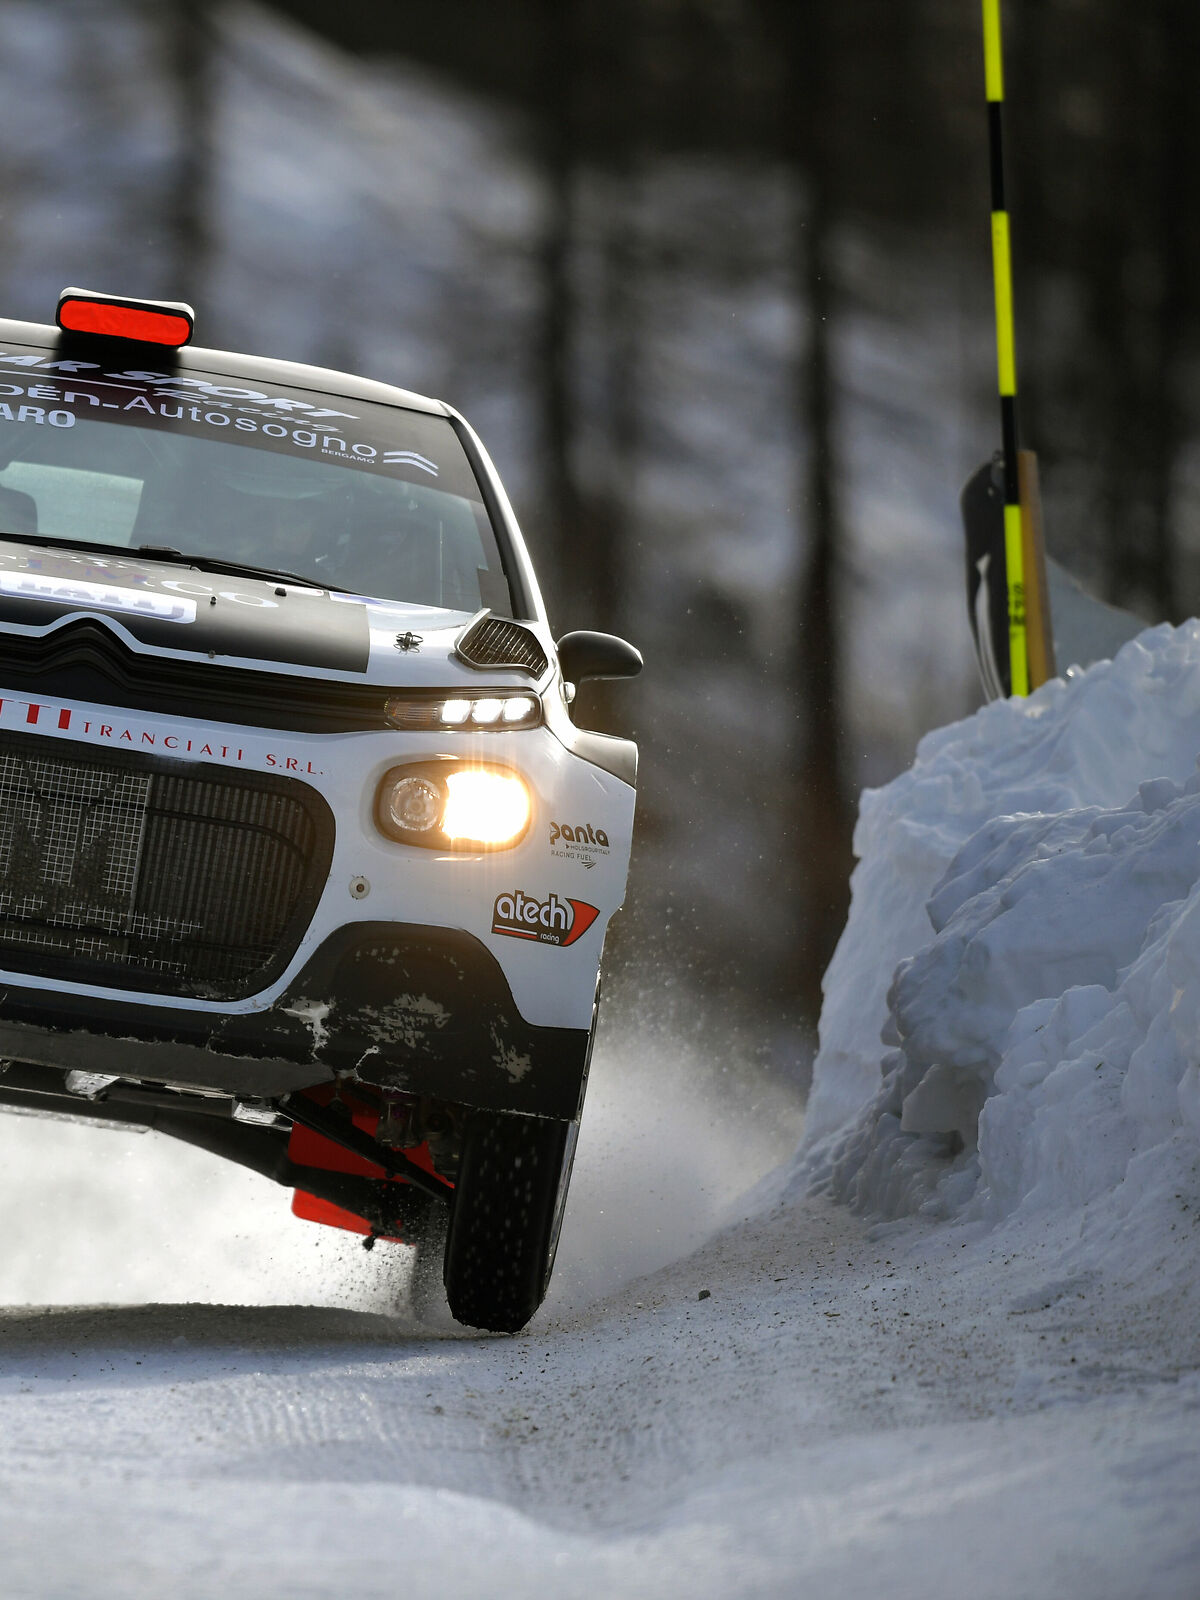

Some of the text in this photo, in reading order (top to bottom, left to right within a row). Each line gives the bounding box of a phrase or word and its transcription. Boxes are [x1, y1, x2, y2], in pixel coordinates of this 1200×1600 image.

[103, 370, 360, 420] SPORT
[321, 448, 375, 464] BERGAMO
[84, 721, 243, 761] TRANCIATI
[266, 752, 324, 775] S.R.L.
[550, 821, 610, 847] panta
[550, 850, 592, 861] RACING FUEL
[496, 894, 565, 930] atech
[540, 933, 560, 944] racing
